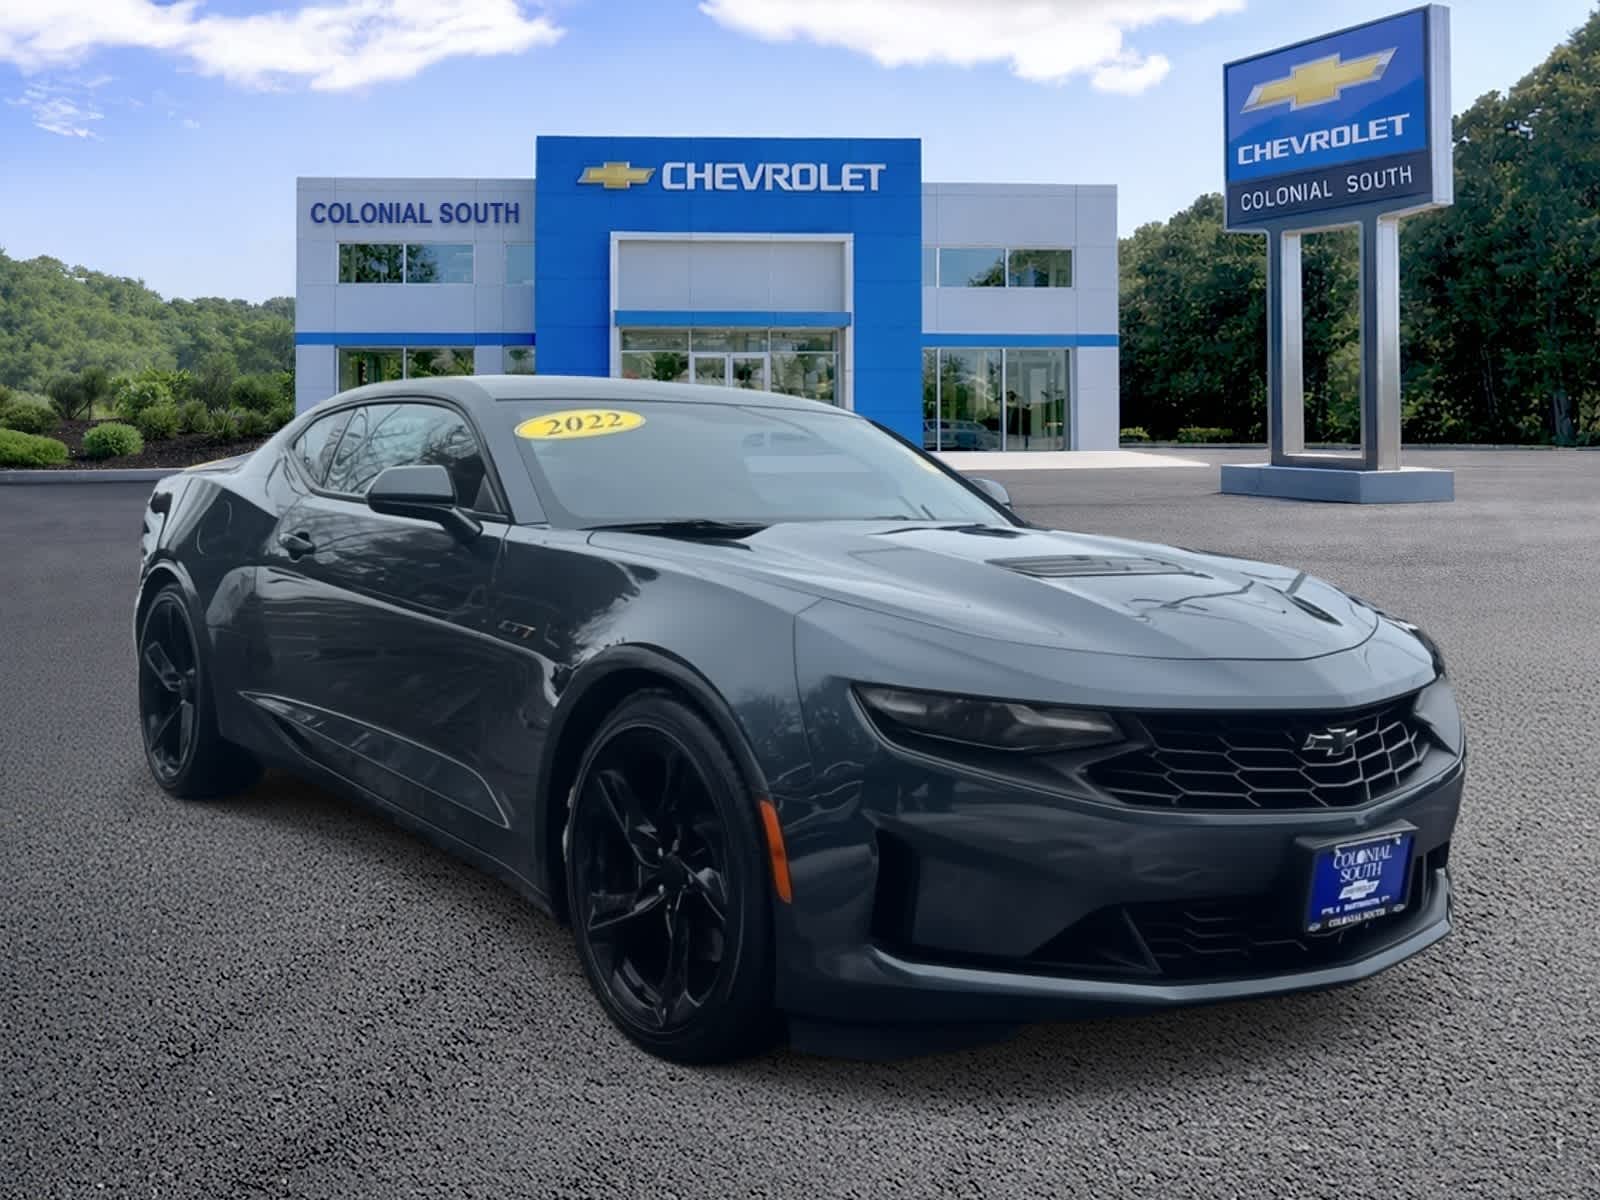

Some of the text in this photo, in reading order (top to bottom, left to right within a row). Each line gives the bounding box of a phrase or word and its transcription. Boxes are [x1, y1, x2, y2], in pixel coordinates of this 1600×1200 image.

[1237, 113, 1410, 165] CHEVROLET
[662, 162, 886, 192] CHEVROLET
[1240, 165, 1413, 212] COLONIAL SOUTH
[311, 202, 520, 224] COLONIAL SOUTH
[544, 412, 623, 436] 2022
[1333, 845, 1392, 869] COLONIAL
[1340, 861, 1382, 882] SOUTH
